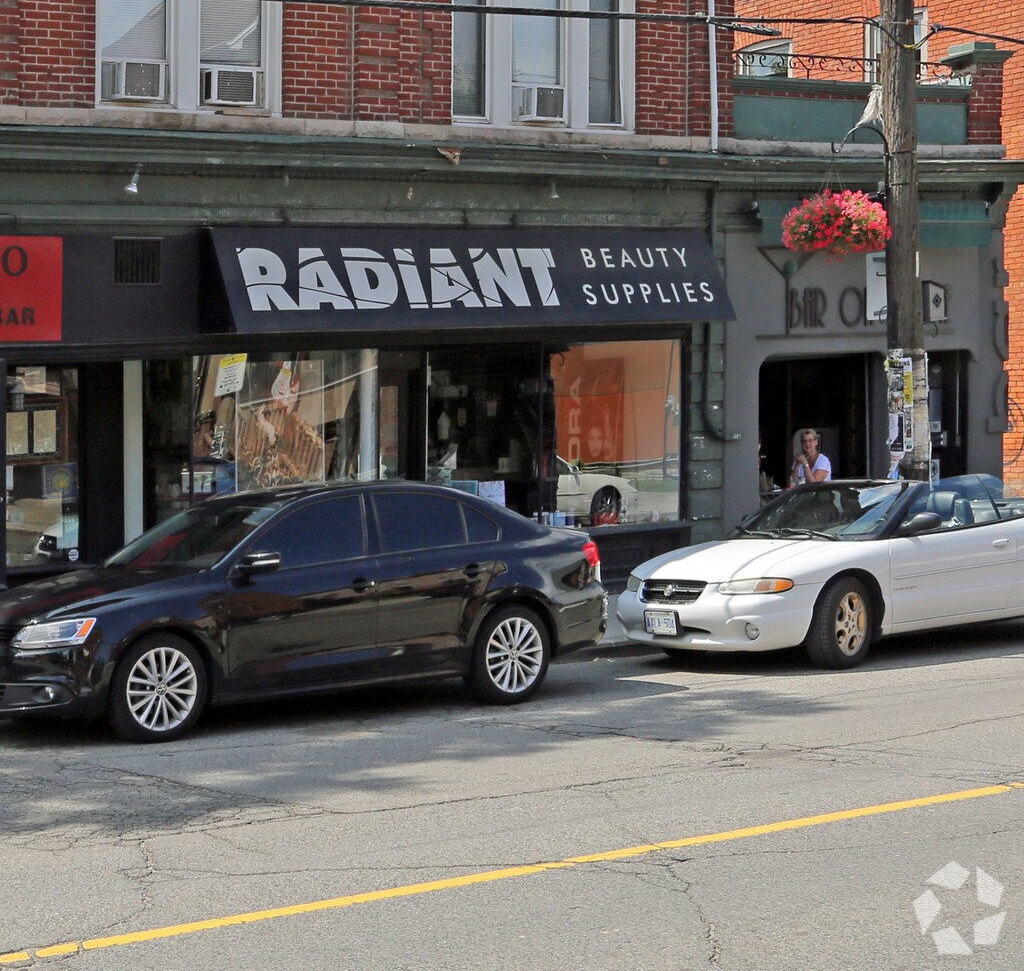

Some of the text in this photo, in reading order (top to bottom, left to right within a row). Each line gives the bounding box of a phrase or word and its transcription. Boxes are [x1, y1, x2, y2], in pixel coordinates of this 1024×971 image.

[580, 248, 689, 269] BEAUTY
[236, 247, 561, 311] RADIANT
[581, 281, 715, 306] SUPPLIES
